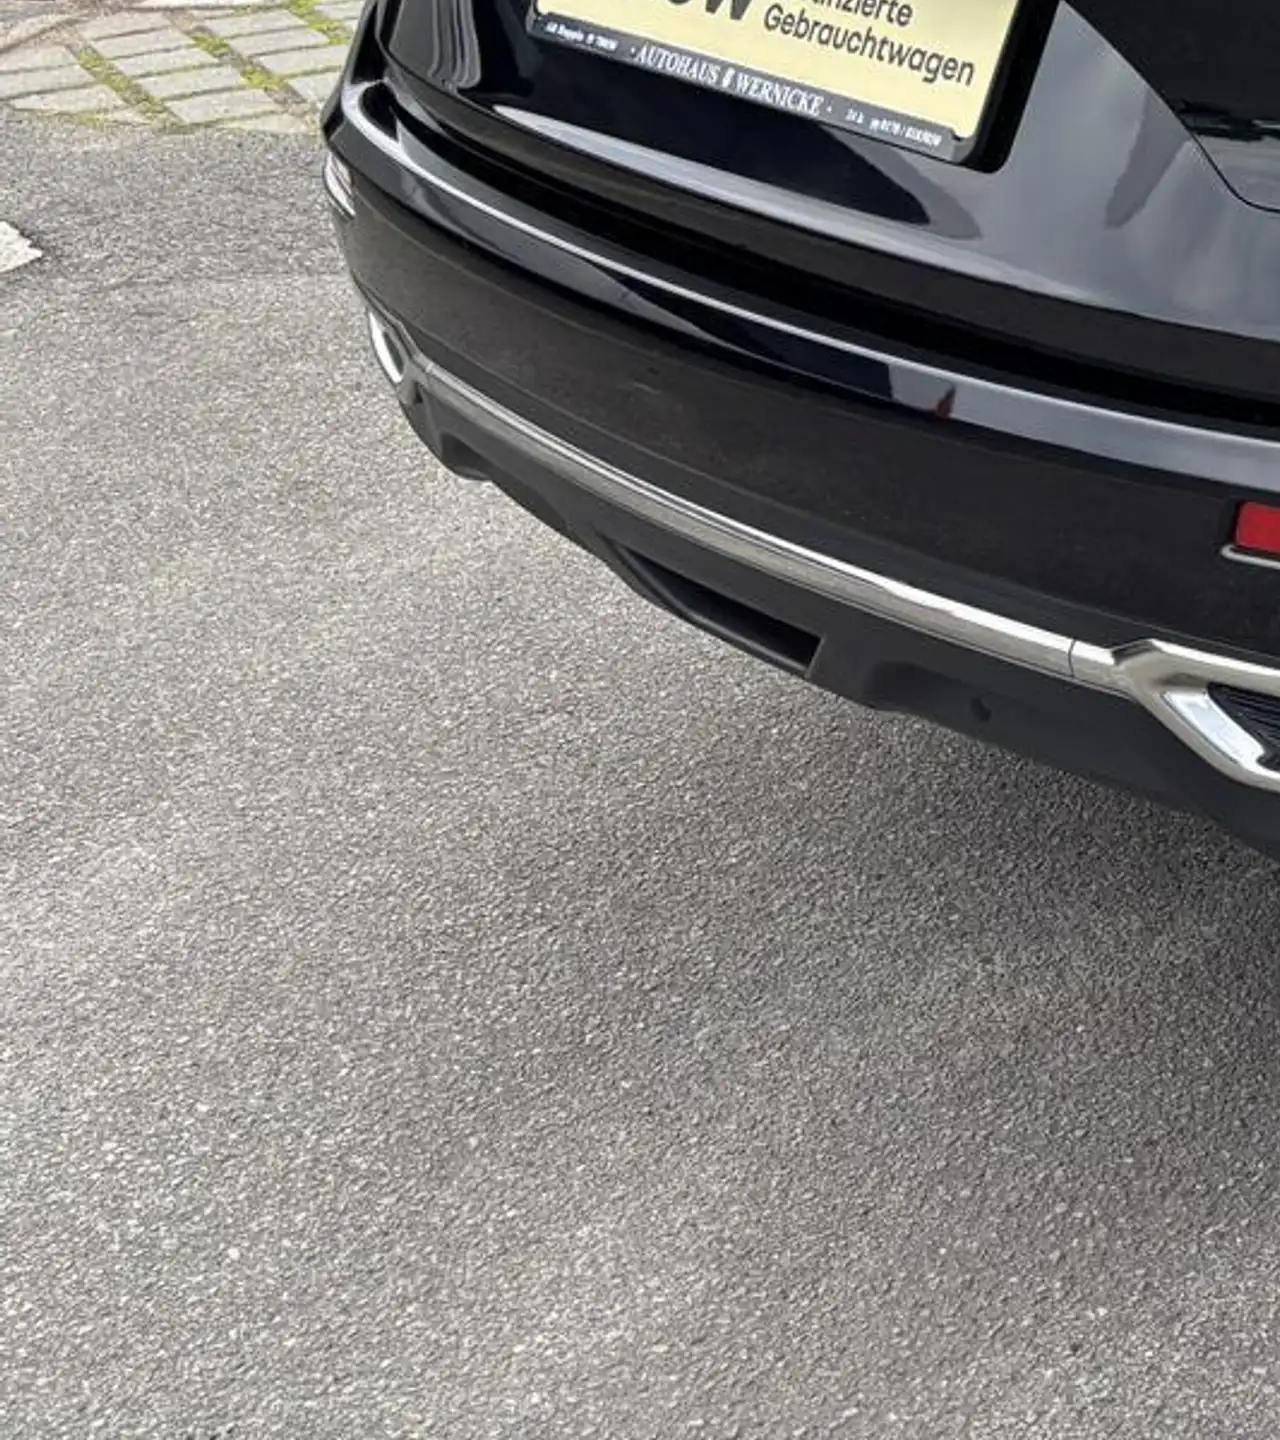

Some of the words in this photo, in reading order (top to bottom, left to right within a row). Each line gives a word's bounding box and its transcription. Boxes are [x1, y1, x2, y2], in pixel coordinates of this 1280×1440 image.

[634, 42, 719, 84] AUTOHAUS
[737, 72, 825, 117] WERNICKE
[763, 3, 976, 87] Gebrauchtwagen
